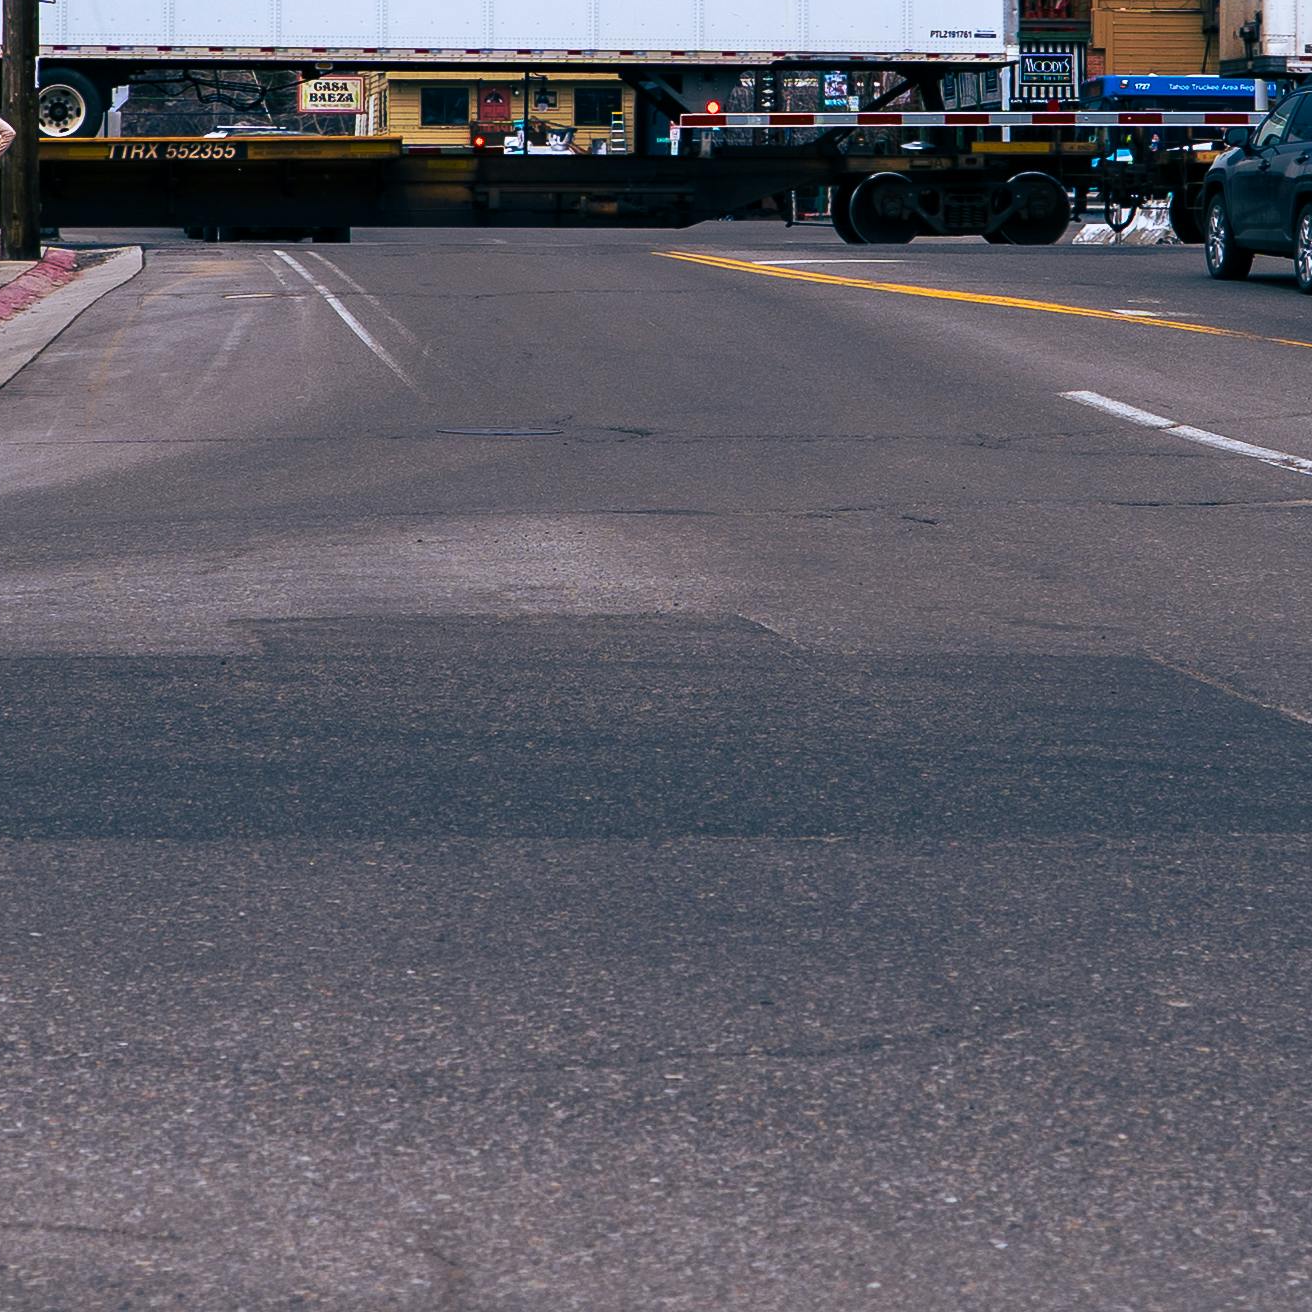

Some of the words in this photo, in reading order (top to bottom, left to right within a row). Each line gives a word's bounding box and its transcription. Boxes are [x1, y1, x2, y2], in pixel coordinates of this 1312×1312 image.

[313, 81, 349, 92] CASA
[309, 92, 354, 103] BAEZA
[108, 143, 159, 159] TTRX
[165, 143, 237, 159] 552355
